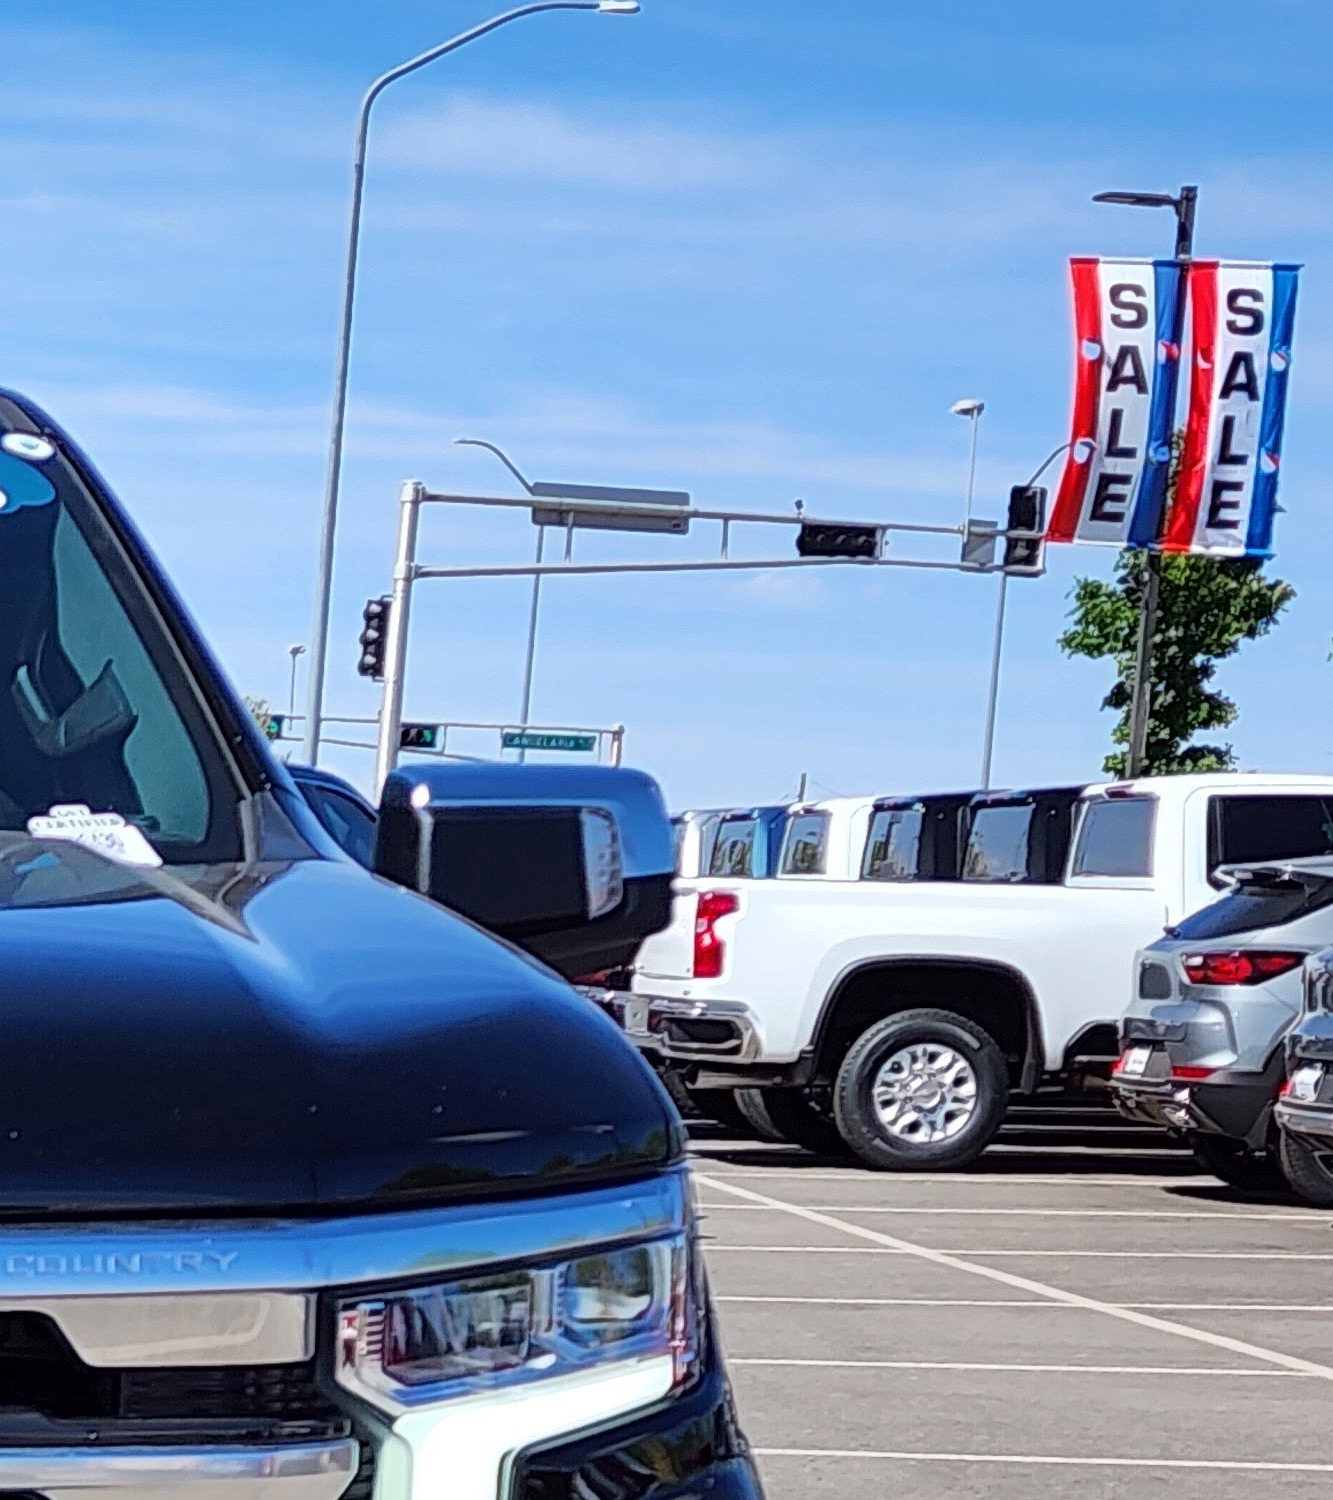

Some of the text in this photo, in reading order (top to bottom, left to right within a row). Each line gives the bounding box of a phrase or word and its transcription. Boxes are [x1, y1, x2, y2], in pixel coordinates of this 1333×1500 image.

[1089, 283, 1149, 523] SALE
[1206, 288, 1265, 530] SALE
[5, 1251, 239, 1275] COUNTRY
